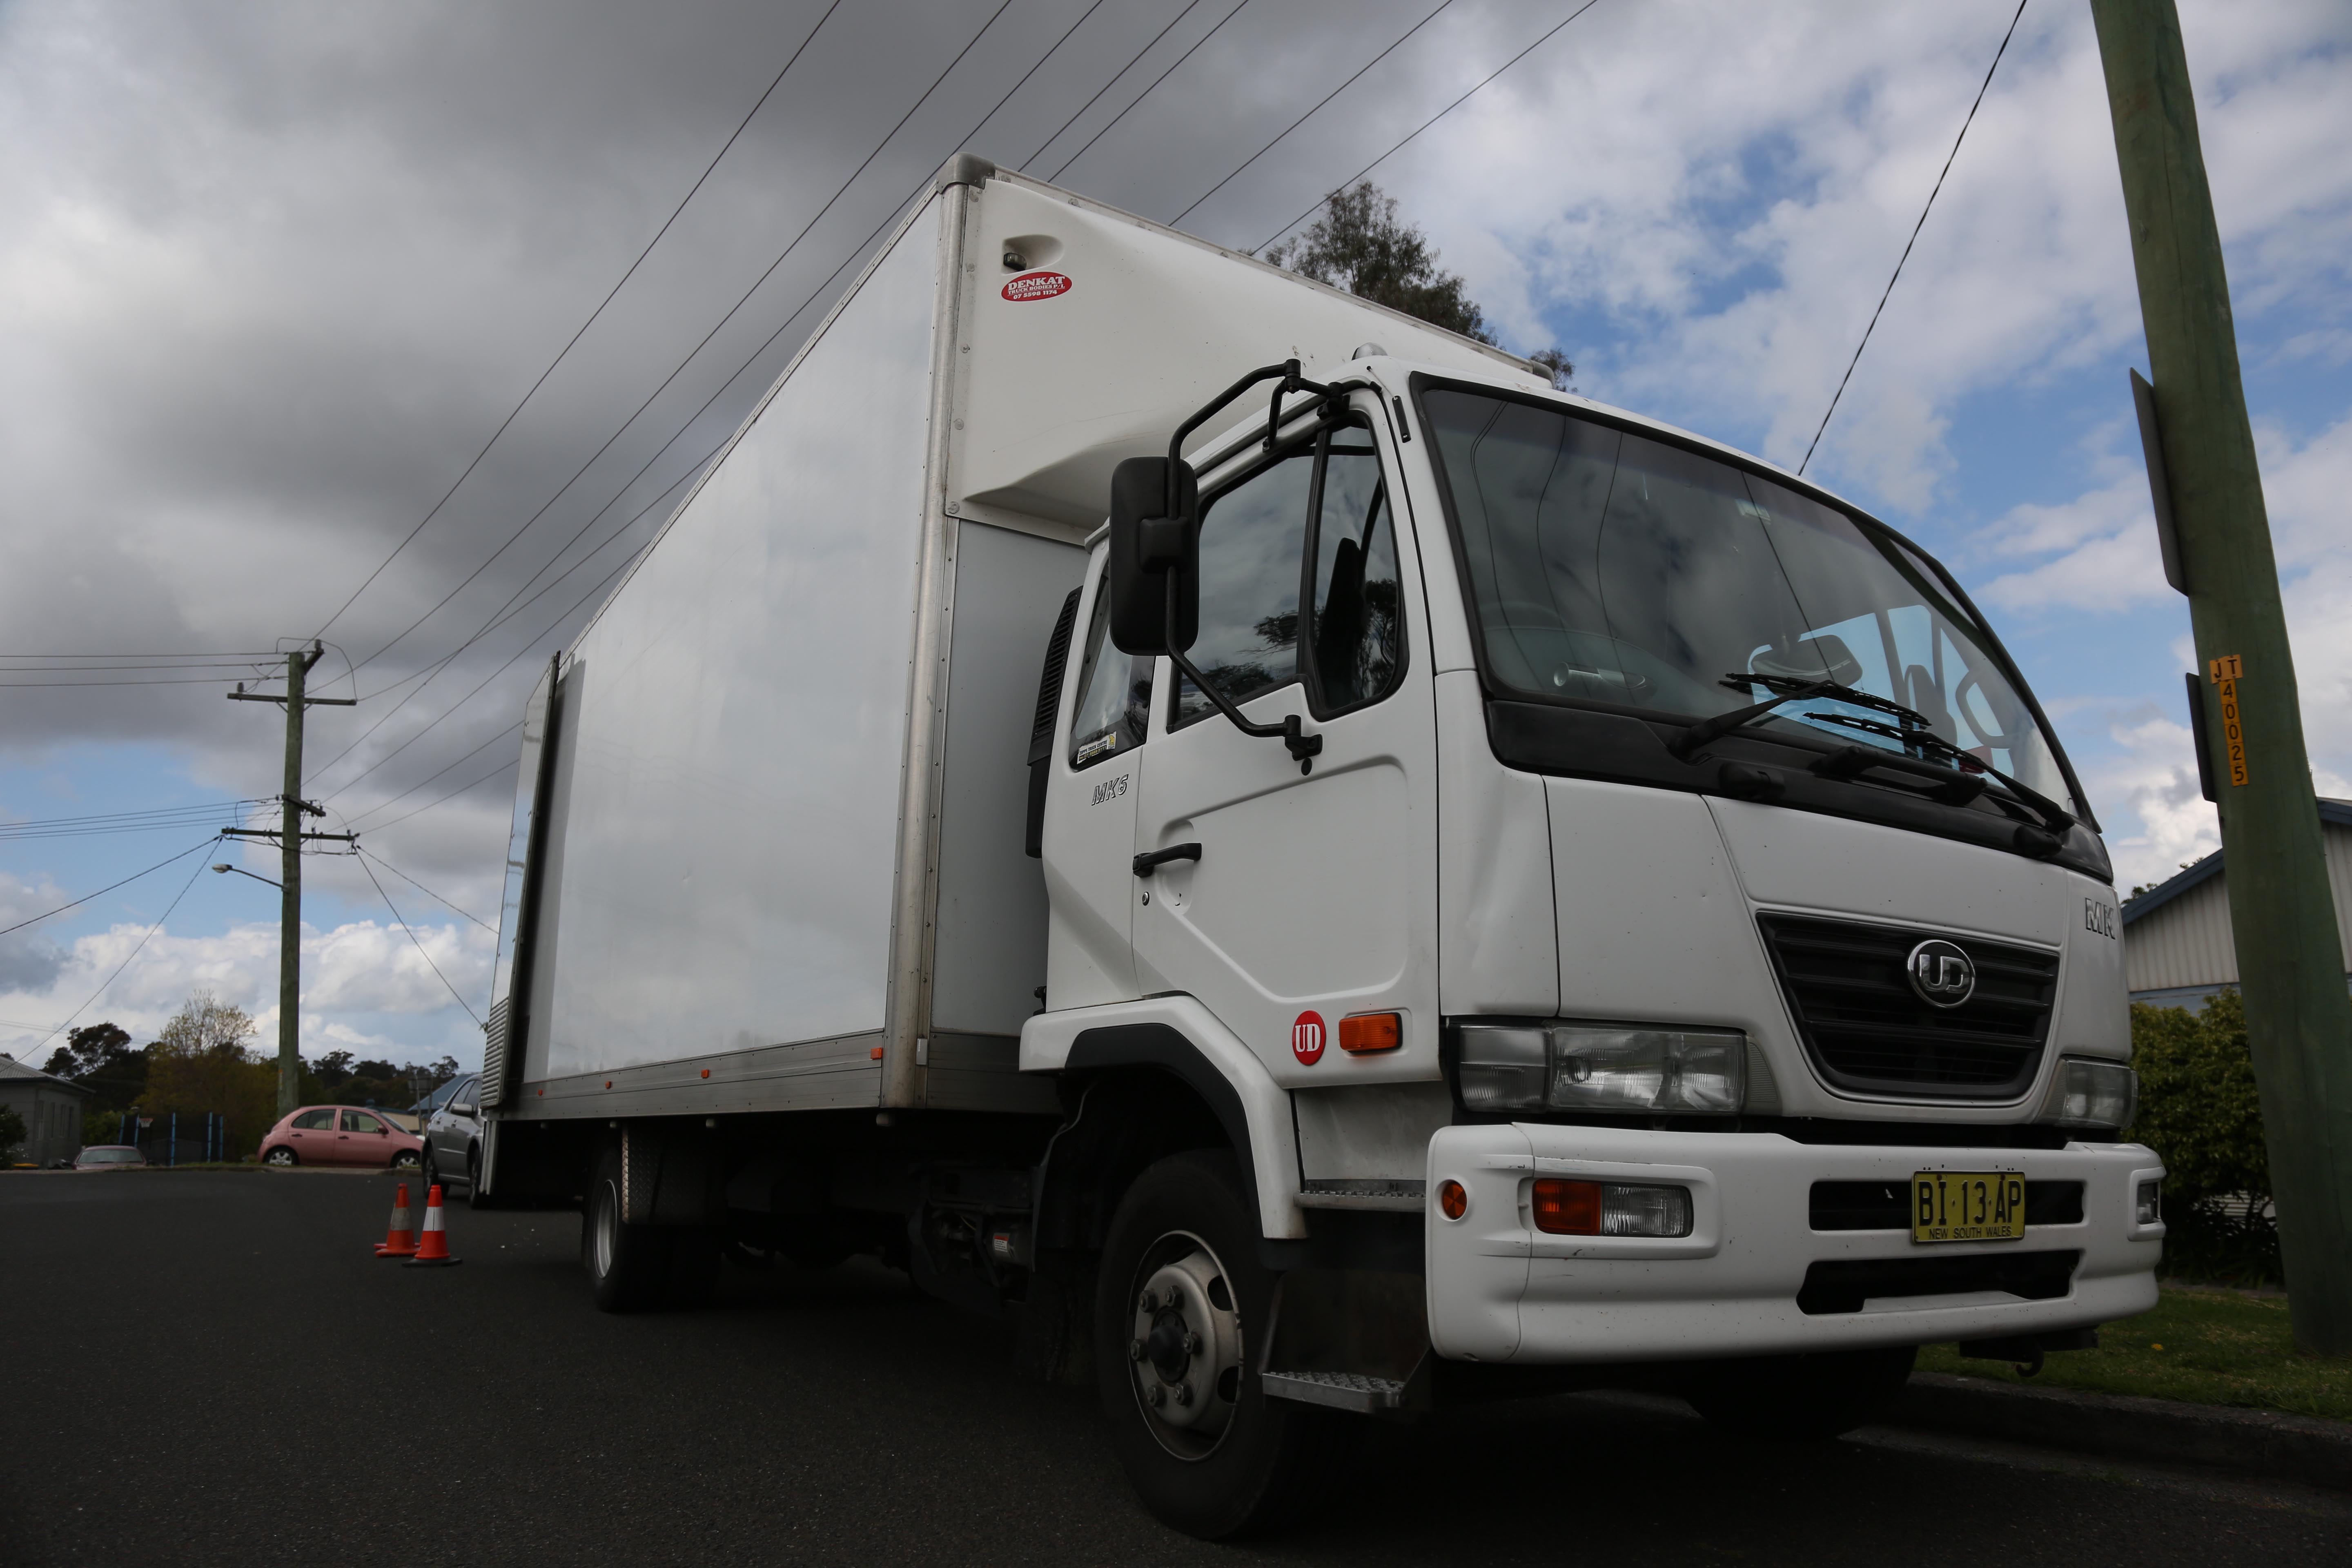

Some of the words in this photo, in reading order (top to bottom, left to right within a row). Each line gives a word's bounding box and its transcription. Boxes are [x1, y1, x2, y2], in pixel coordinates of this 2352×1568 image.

[1008, 276, 1065, 291] DENKAT
[2214, 659, 2237, 678] JT
[2223, 683, 2244, 782] 40025
[1091, 774, 1129, 806] MK6
[2085, 898, 2116, 940] MK
[1920, 954, 1969, 993] UD
[1295, 1024, 1321, 1052] UD
[1929, 1228, 1948, 1239] NEW
[1954, 1227, 1982, 1238] SOUTH
[1987, 1225, 2011, 1237] WALES
